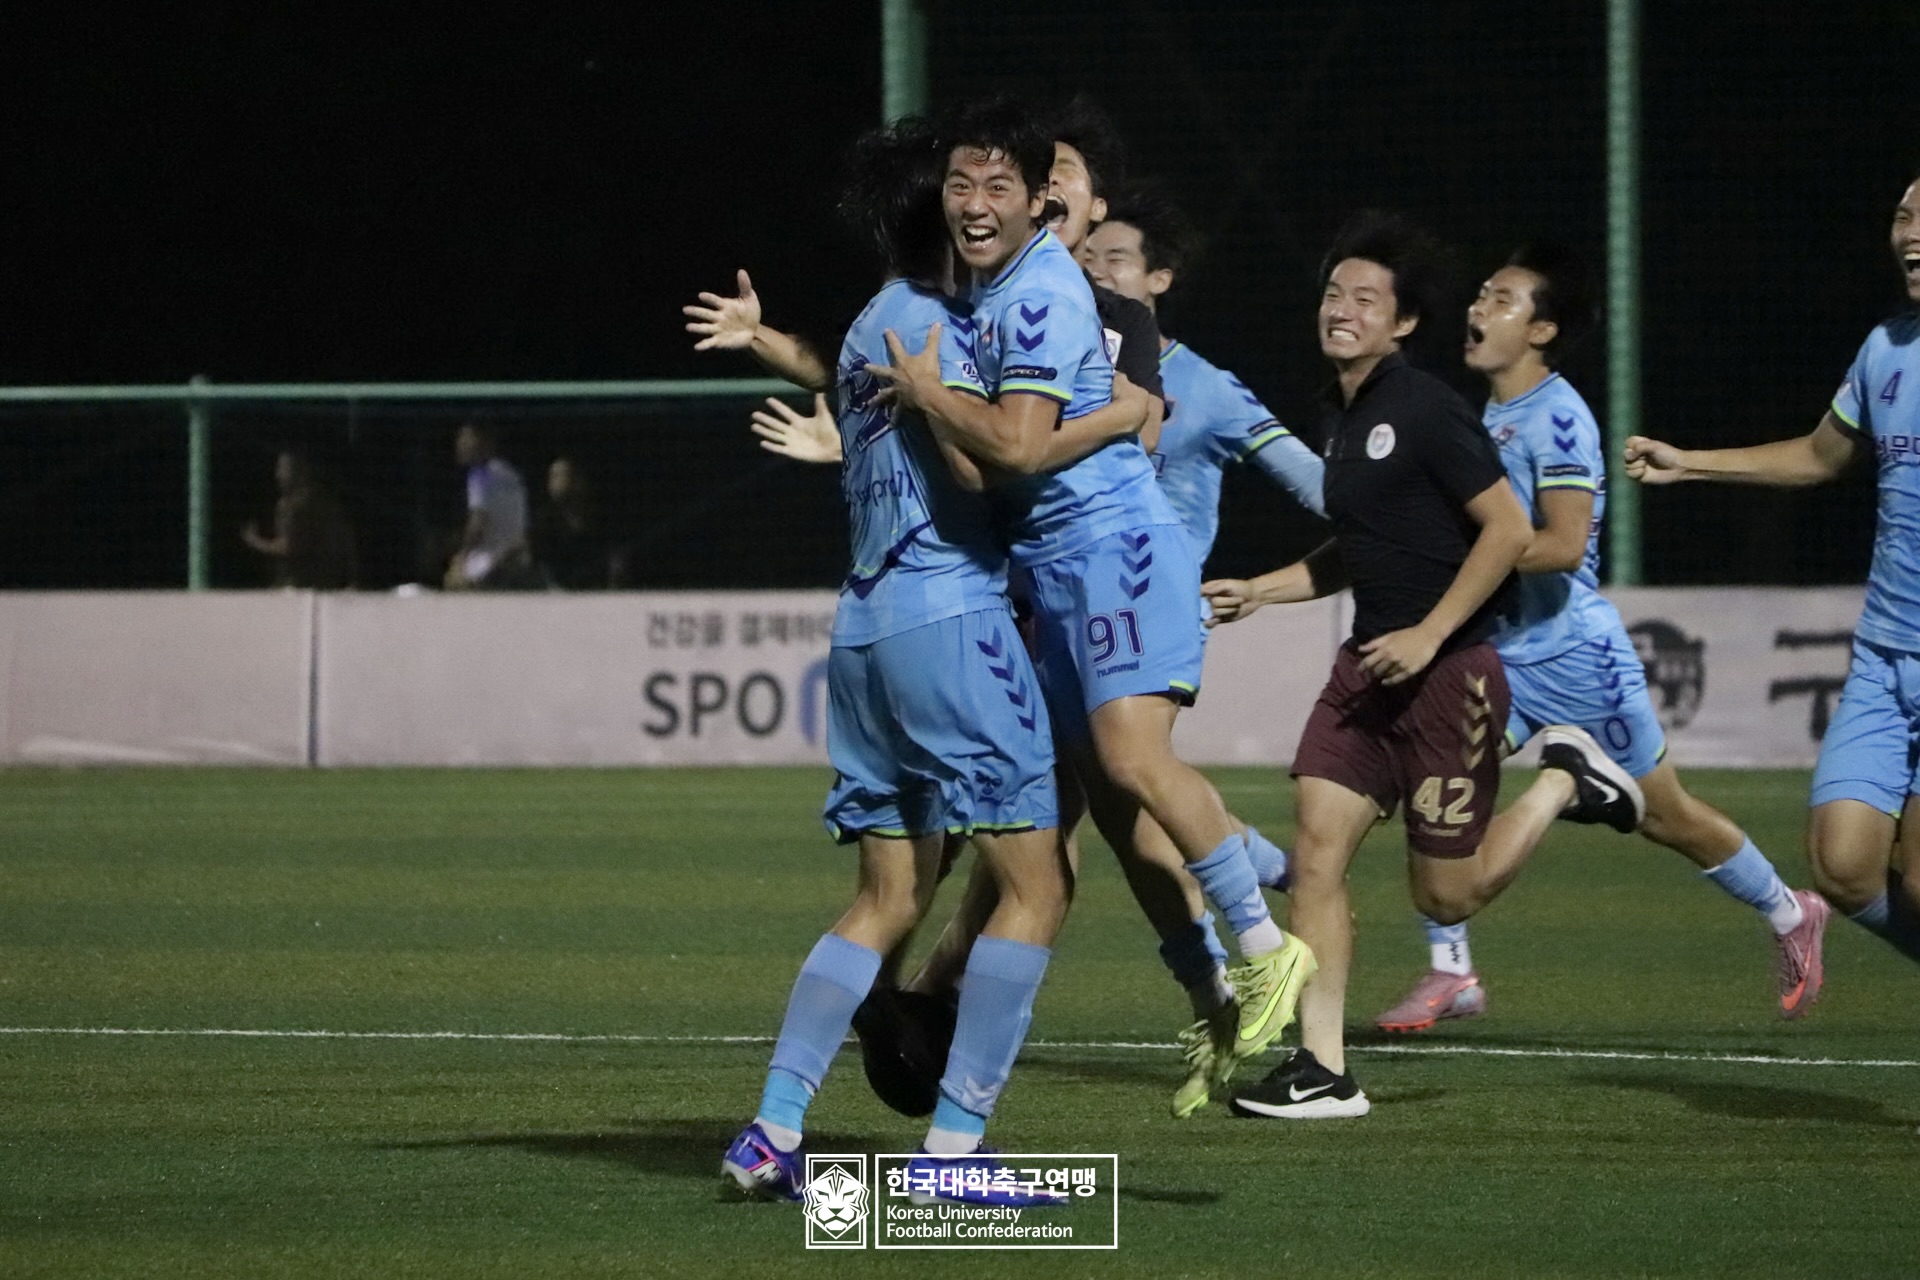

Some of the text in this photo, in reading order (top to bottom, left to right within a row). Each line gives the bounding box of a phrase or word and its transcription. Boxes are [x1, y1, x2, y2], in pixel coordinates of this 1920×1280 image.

[1879, 369, 1903, 408] 4
[1087, 608, 1144, 665] 91
[1096, 661, 1140, 679] hummel
[1411, 776, 1475, 825] 42
